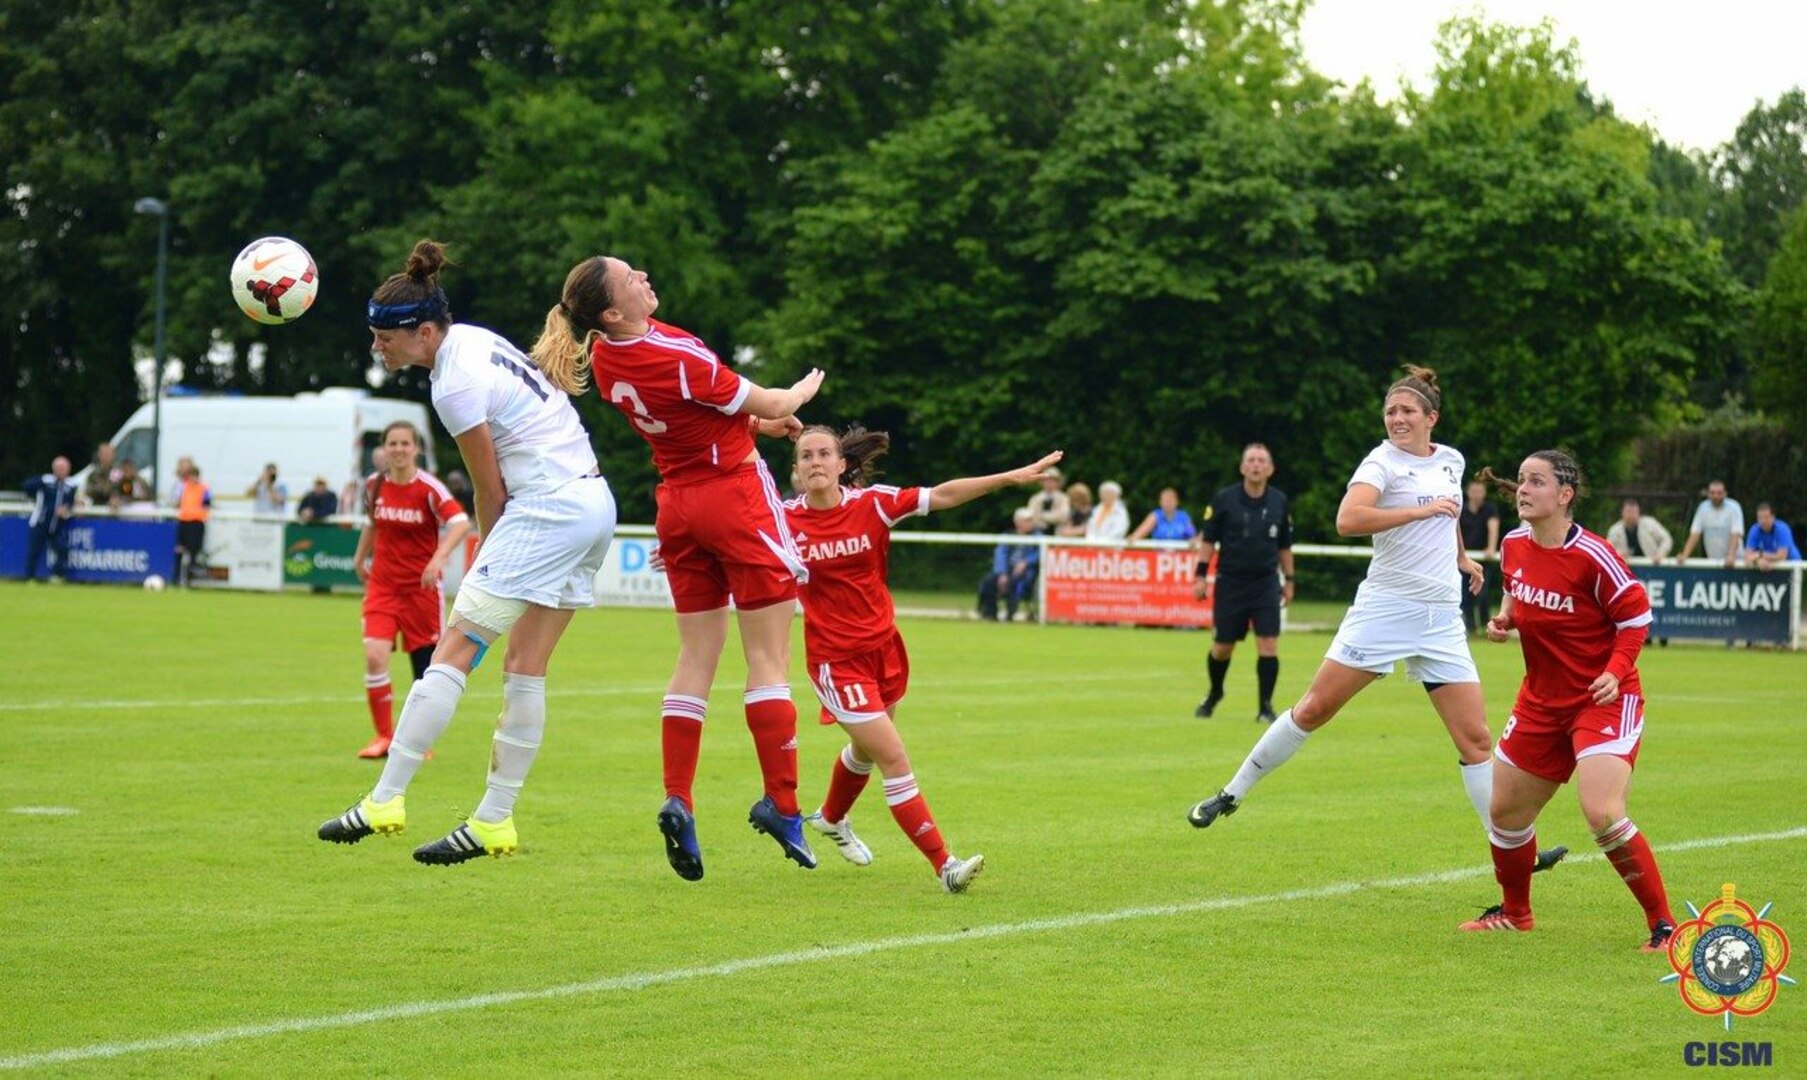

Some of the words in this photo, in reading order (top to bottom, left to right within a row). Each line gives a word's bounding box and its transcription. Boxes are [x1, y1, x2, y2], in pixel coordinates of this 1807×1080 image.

[1046, 551, 1150, 581] Meubles
[1510, 580, 1574, 613] CANADA
[1643, 578, 1668, 608] E
[1674, 580, 1787, 612] LAUNAY
[843, 684, 868, 708] 11
